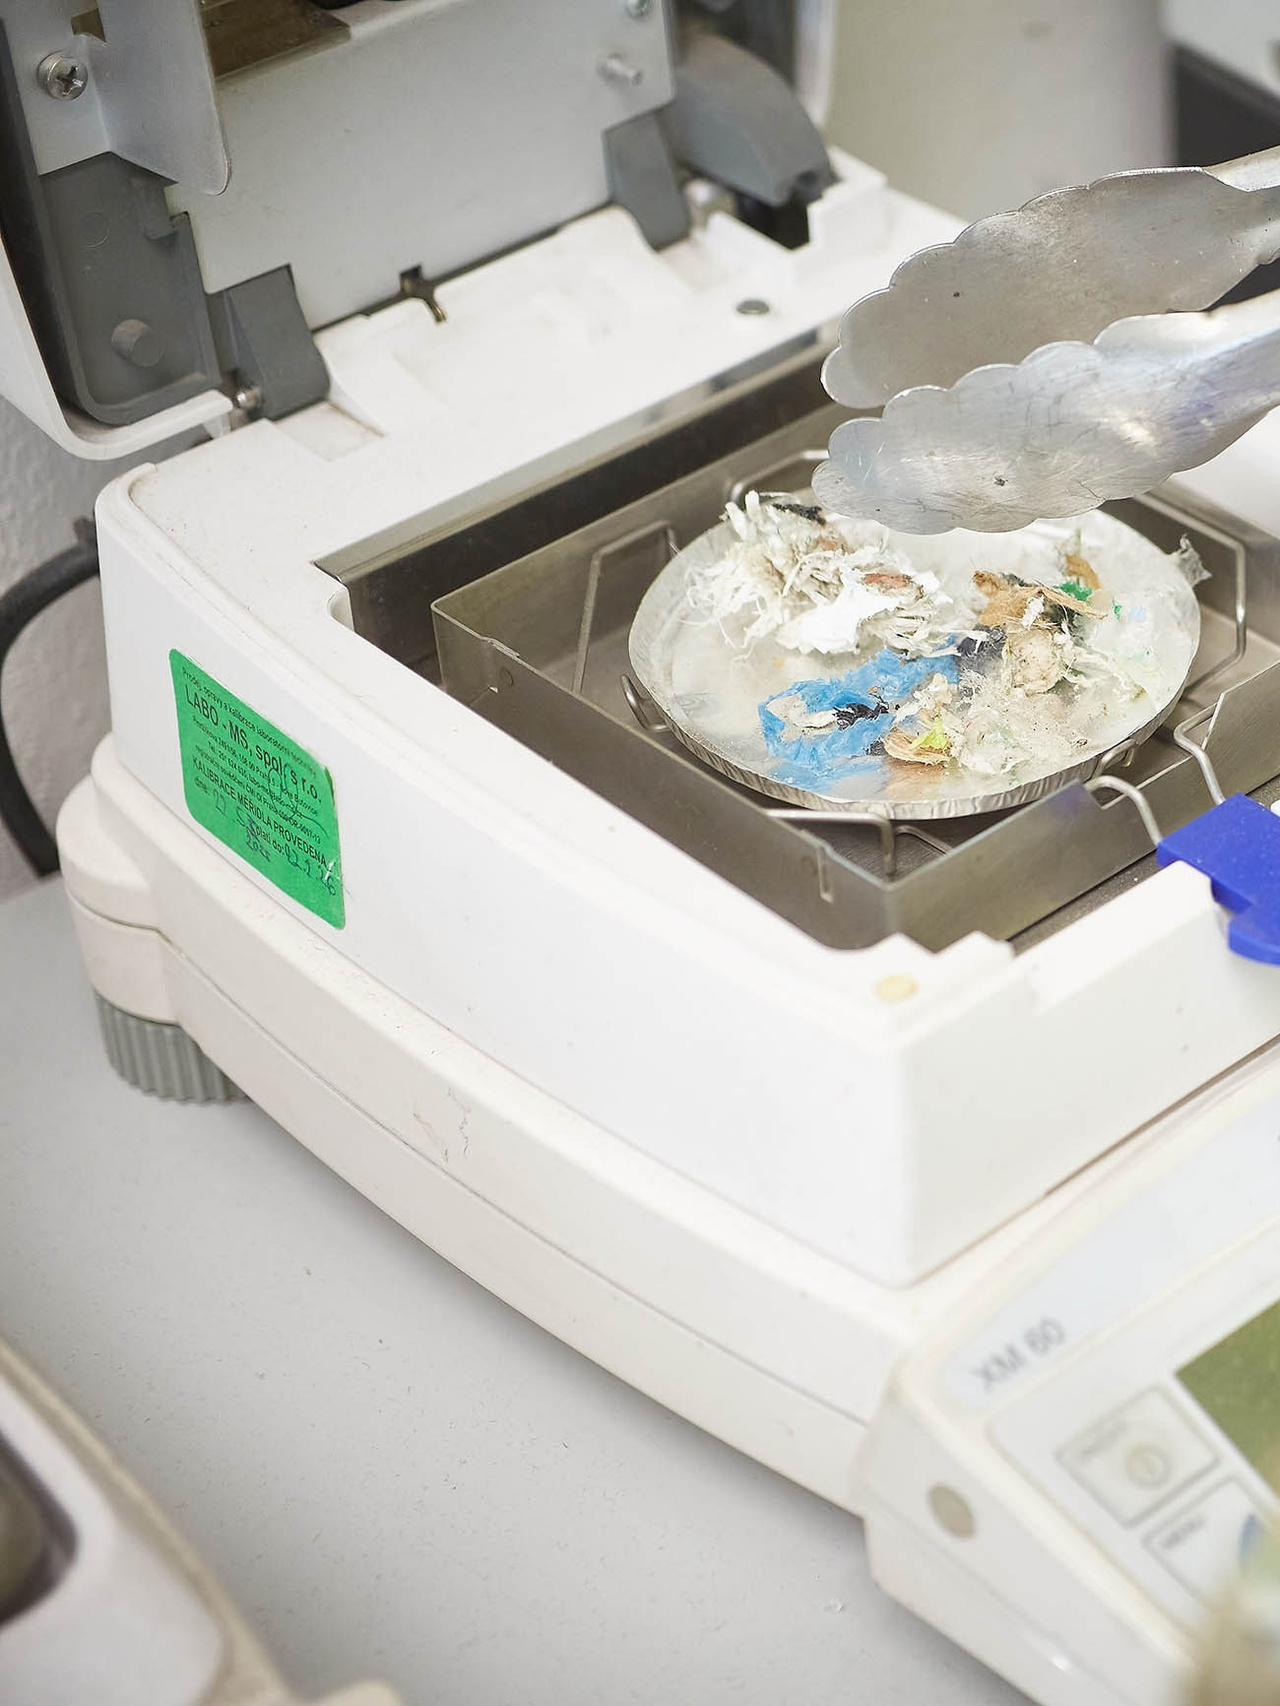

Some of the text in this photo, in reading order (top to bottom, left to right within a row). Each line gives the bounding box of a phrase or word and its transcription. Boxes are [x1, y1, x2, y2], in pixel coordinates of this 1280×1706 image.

[184, 684, 219, 728] LABO
[229, 719, 252, 757] MS,
[289, 767, 297, 786] s
[301, 775, 321, 804] r.o.
[192, 755, 235, 800] KALIBRACE
[237, 788, 272, 830] MĚŘIDLA
